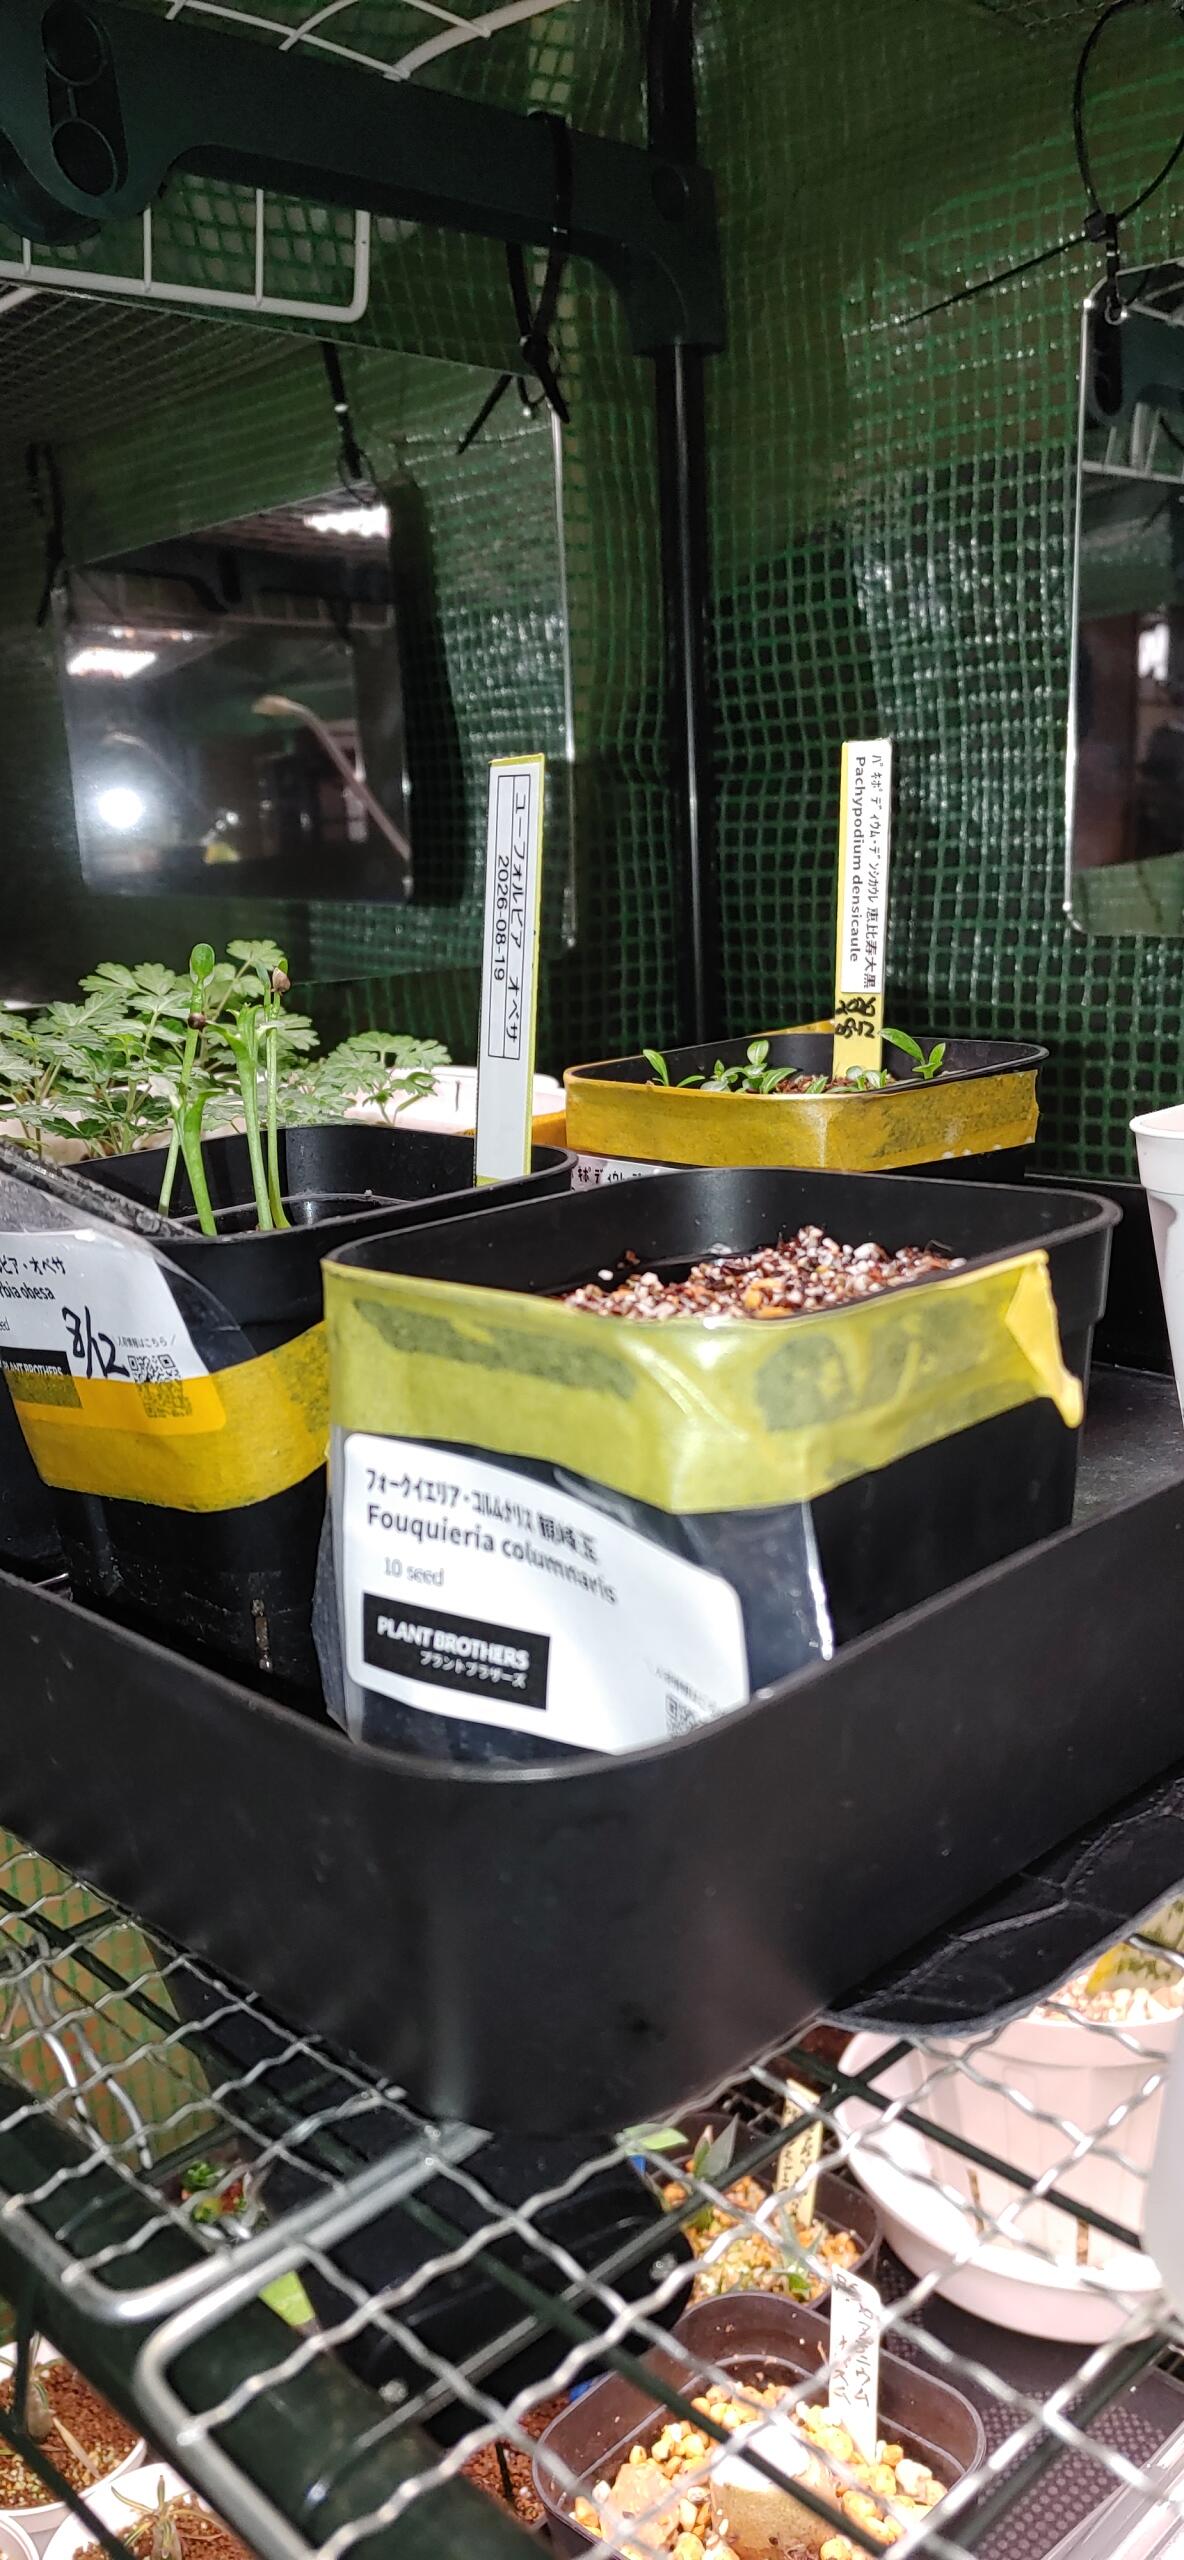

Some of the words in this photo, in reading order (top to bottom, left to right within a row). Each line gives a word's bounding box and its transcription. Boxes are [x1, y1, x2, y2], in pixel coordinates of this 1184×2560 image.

[851, 756, 866, 871] Pachypodium
[509, 792, 526, 949] ユーフォルビア
[493, 854, 509, 981] 2026-08-19
[849, 874, 863, 962] densicaule
[863, 906, 879, 989] 恵比寿大黒
[505, 976, 520, 1043] オベサ
[20, 1281, 56, 1300] obesa
[62, 1305, 131, 1379] 8/12
[366, 1502, 495, 1552] Fouquieria
[501, 1538, 619, 1606] columnaris
[384, 1556, 403, 1578] 10
[406, 1566, 445, 1587] seed
[376, 1615, 435, 1648] PLANT
[433, 1630, 531, 1671] BROTHERS
[419, 1650, 528, 1690] プラントブラザーズ
